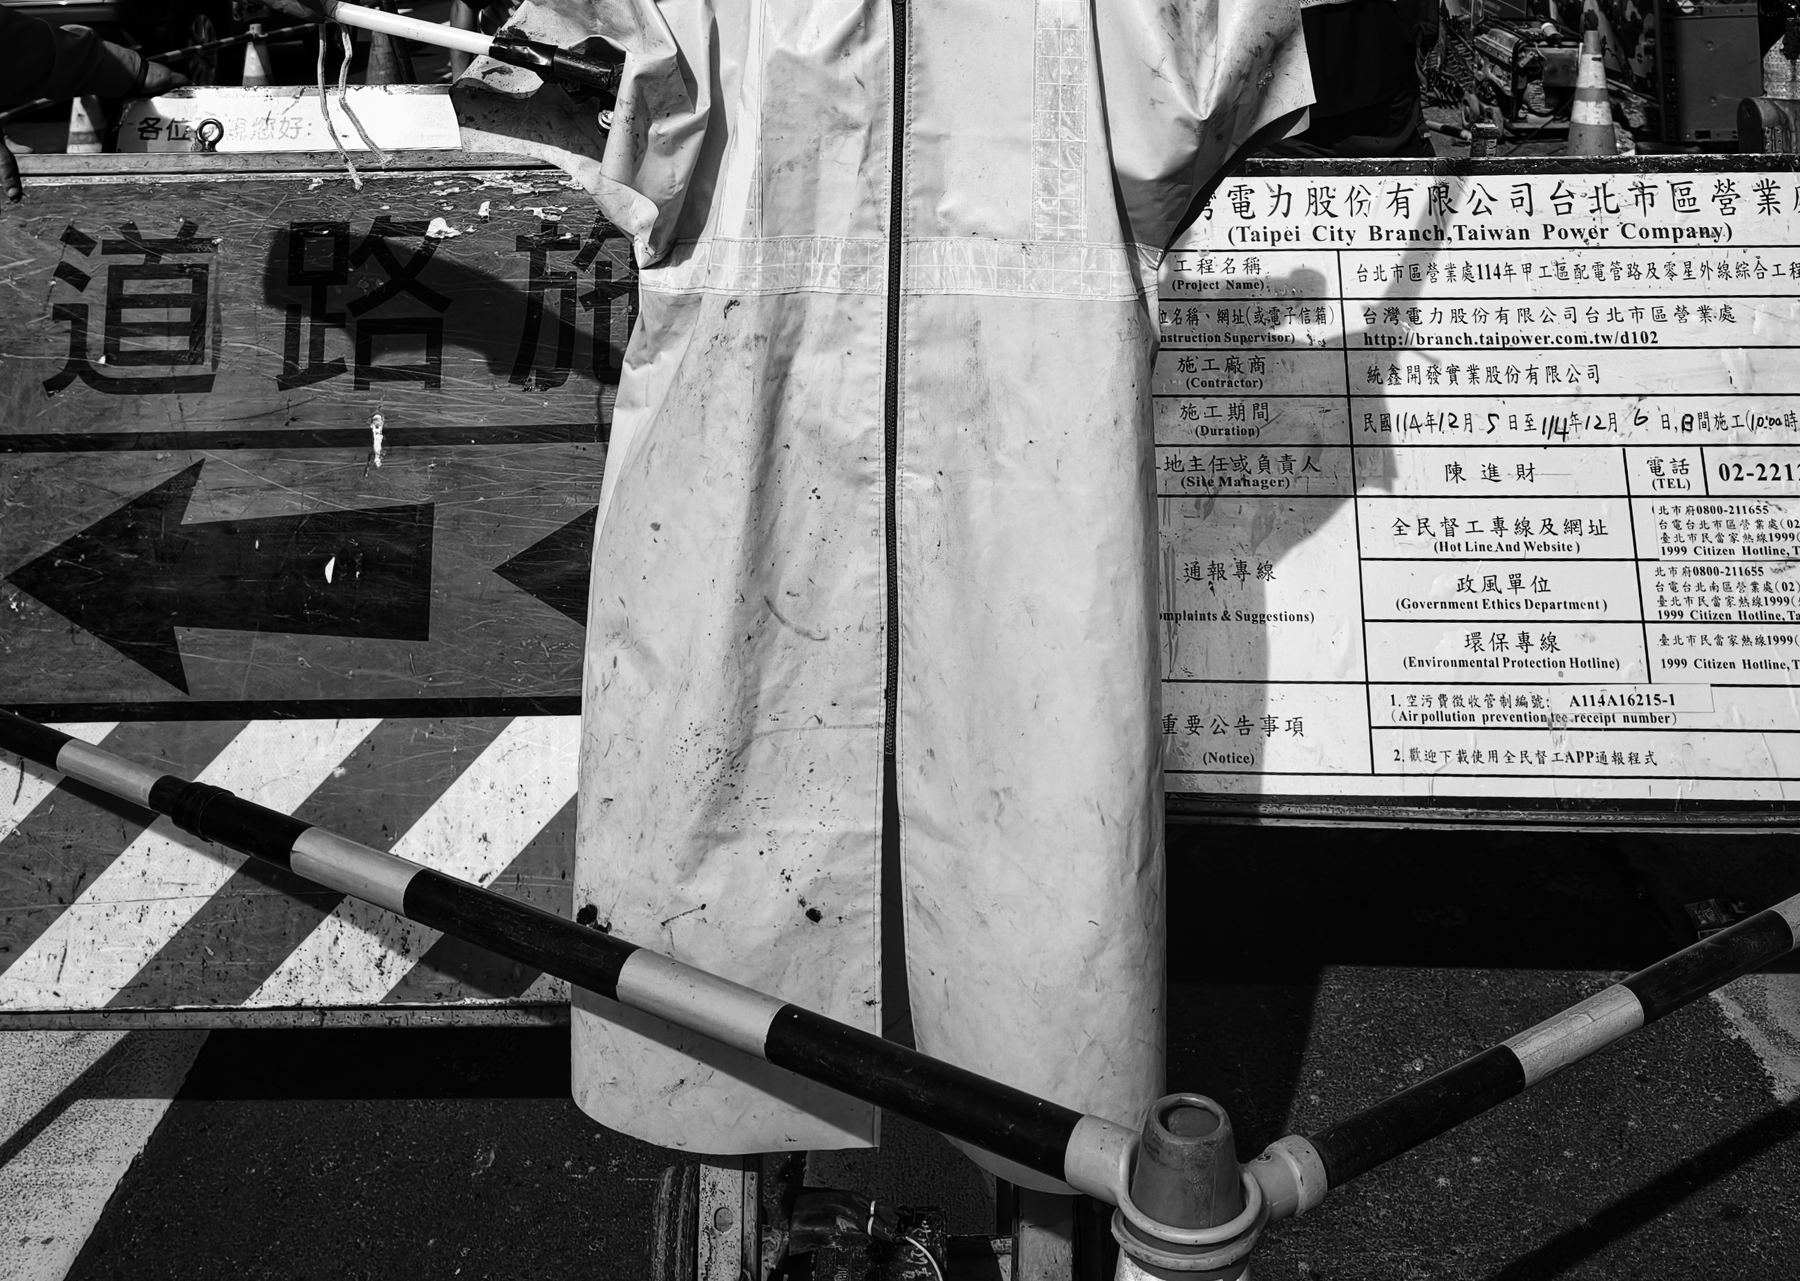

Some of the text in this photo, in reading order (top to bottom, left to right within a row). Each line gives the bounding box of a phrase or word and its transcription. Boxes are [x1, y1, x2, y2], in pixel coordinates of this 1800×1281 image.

[1203, 178, 1800, 221] 電力股份有限公司台北市區營業
[1228, 225, 1302, 247] (Taipei
[1312, 224, 1357, 246] City
[1542, 223, 1609, 241] Power
[1620, 222, 1733, 243] Company)
[1173, 256, 1263, 276] 工程名稱
[1171, 279, 1265, 292] (Project Name)
[1362, 303, 1737, 326] 台灣電力股份有限公司台北市區營業處
[1224, 332, 1296, 345] Supervisor)
[1364, 330, 1660, 348] http://branch.taipower.com.tw/d102
[1177, 355, 1266, 375] 施工廠商
[1185, 376, 1264, 390] (Contractor)
[1366, 363, 1601, 386] 統鑫開發實業股份有限公司
[1179, 402, 1269, 423] 施工期間
[1194, 424, 1261, 439] (Duration)
[1156, 454, 1322, 475] 地主任或負責人
[1444, 462, 1536, 484] 陳進財
[1646, 456, 1691, 477] 電話
[1718, 462, 1800, 482] 02-221
[1218, 476, 1291, 490] Manager)
[1651, 478, 1691, 491] (TEL)
[1391, 516, 1609, 538] 全民督工專線及網址
[1433, 541, 1462, 554] (Hot
[1465, 541, 1493, 553] Line
[1495, 541, 1521, 553] And
[1661, 546, 1688, 556] 1999
[1693, 546, 1736, 556] Citizen
[1183, 559, 1277, 583] 通報專線
[1456, 572, 1552, 595] 政風單位
[1395, 598, 1479, 612] (Government
[1482, 598, 1522, 610] Ethics
[1220, 610, 1232, 622] &
[1235, 610, 1315, 625] Suggestions)
[1657, 609, 1684, 620] 1999
[1690, 610, 1732, 620] Citizen
[1464, 630, 1562, 654] 環保專線
[1402, 656, 1620, 670] (Environmental Protection Hotline)
[1661, 658, 1688, 669] 1999
[1693, 659, 1736, 669] Citizen
[1569, 693, 1676, 708] A114A16215-1
[1161, 714, 1305, 737] 重要公告事項
[1482, 711, 1548, 724] prevention
[1574, 713, 1616, 726] receipt
[1622, 713, 1677, 726] number)
[1202, 751, 1255, 766] (Notice)
